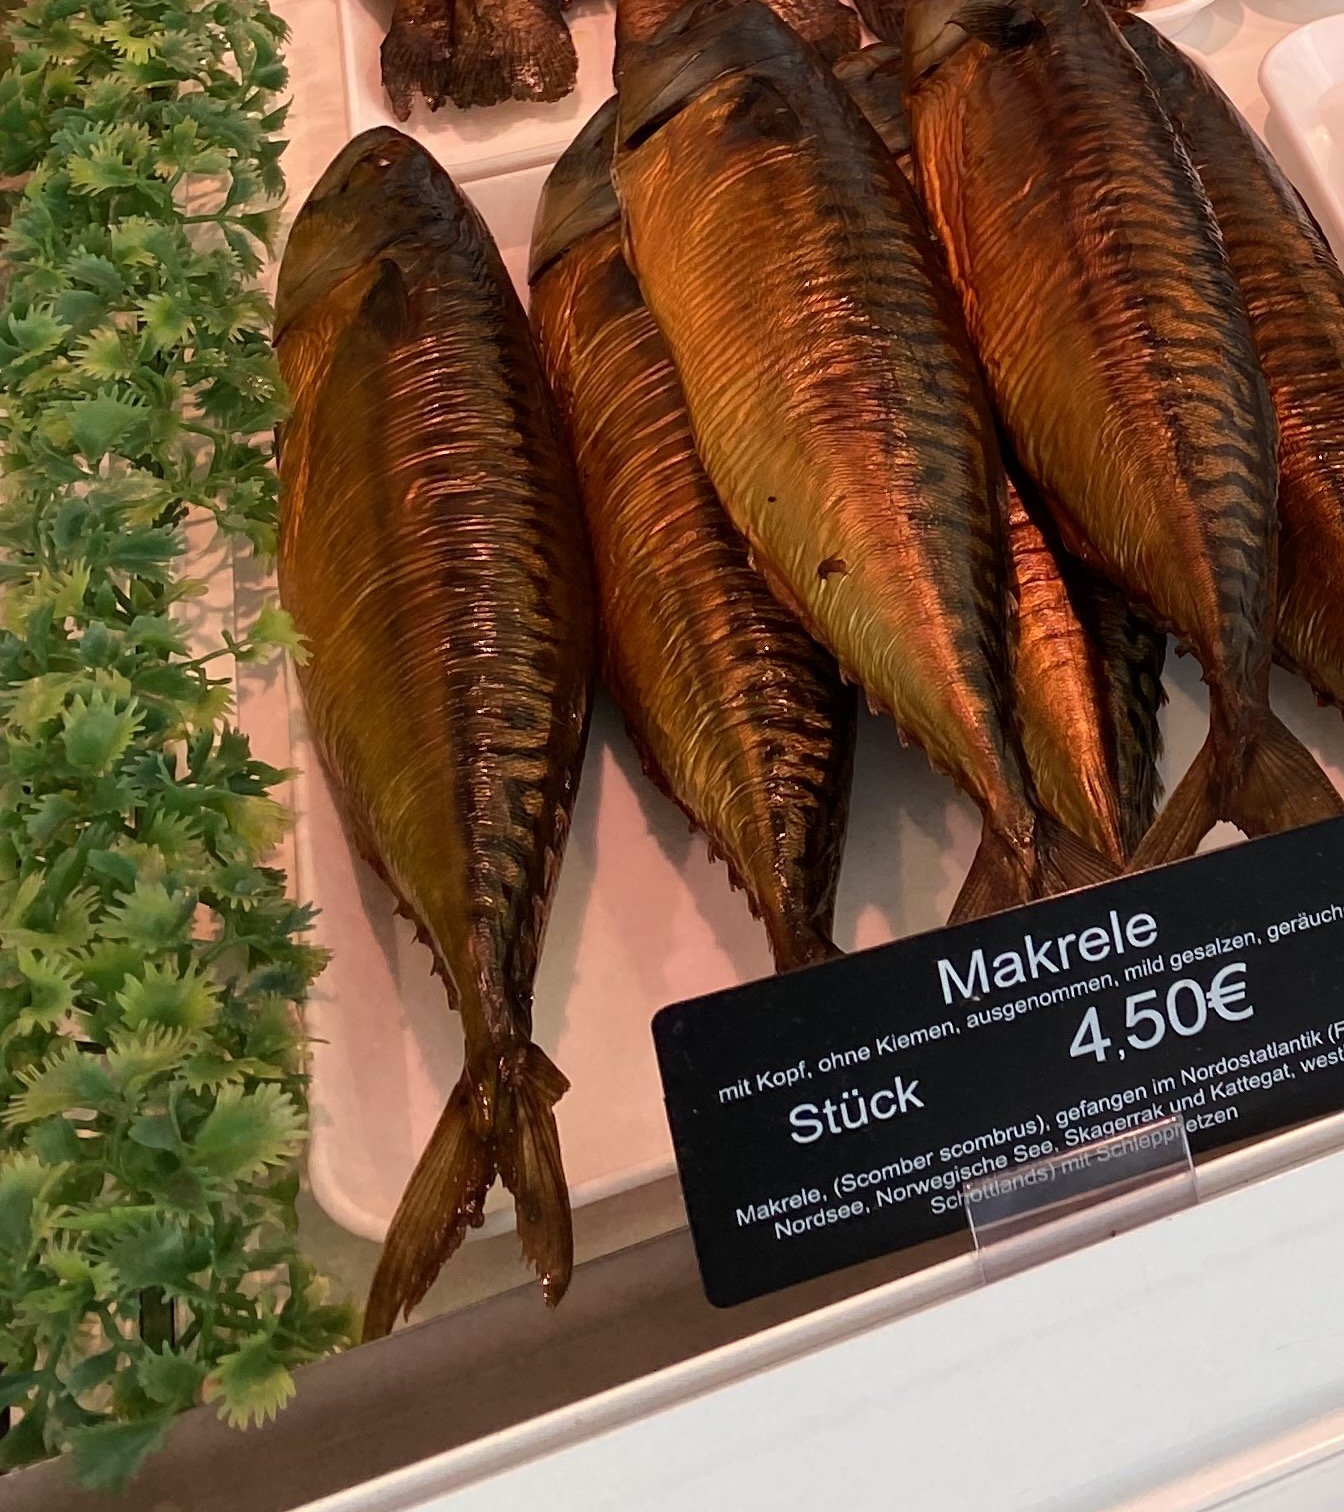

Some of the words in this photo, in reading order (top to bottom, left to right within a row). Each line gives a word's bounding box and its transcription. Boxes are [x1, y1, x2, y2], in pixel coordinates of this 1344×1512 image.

[938, 911, 1157, 1004] Makrele
[719, 1080, 751, 1102] mit
[757, 1061, 812, 1091] Kopf,
[819, 1047, 870, 1072] ohne
[876, 1022, 960, 1055] Kiemen,
[967, 975, 1118, 1028] ausgenommen,
[1125, 955, 1164, 981] mild
[1170, 932, 1261, 971] gesalzen,
[1070, 963, 1253, 1061] 4,50€
[736, 1189, 826, 1226] Makrele,
[834, 1152, 933, 1198] (Scomber
[940, 1115, 1050, 1161] scombrus),
[1056, 1083, 1148, 1129] gefangen
[1153, 1077, 1176, 1095] im
[1181, 1030, 1323, 1080] Nordostatlantik
[775, 1195, 869, 1239] Nordsee,
[877, 1157, 1008, 1206] Norwegische
[1014, 1141, 1058, 1162] See,
[1064, 1106, 1164, 1146] Skagerrak
[1171, 1089, 1205, 1114] und
[1210, 1063, 1295, 1100] Kattegat,
[790, 1077, 924, 1143] Stück
[930, 1160, 1056, 1214] Schottlands)
[1061, 1152, 1091, 1175] mit
